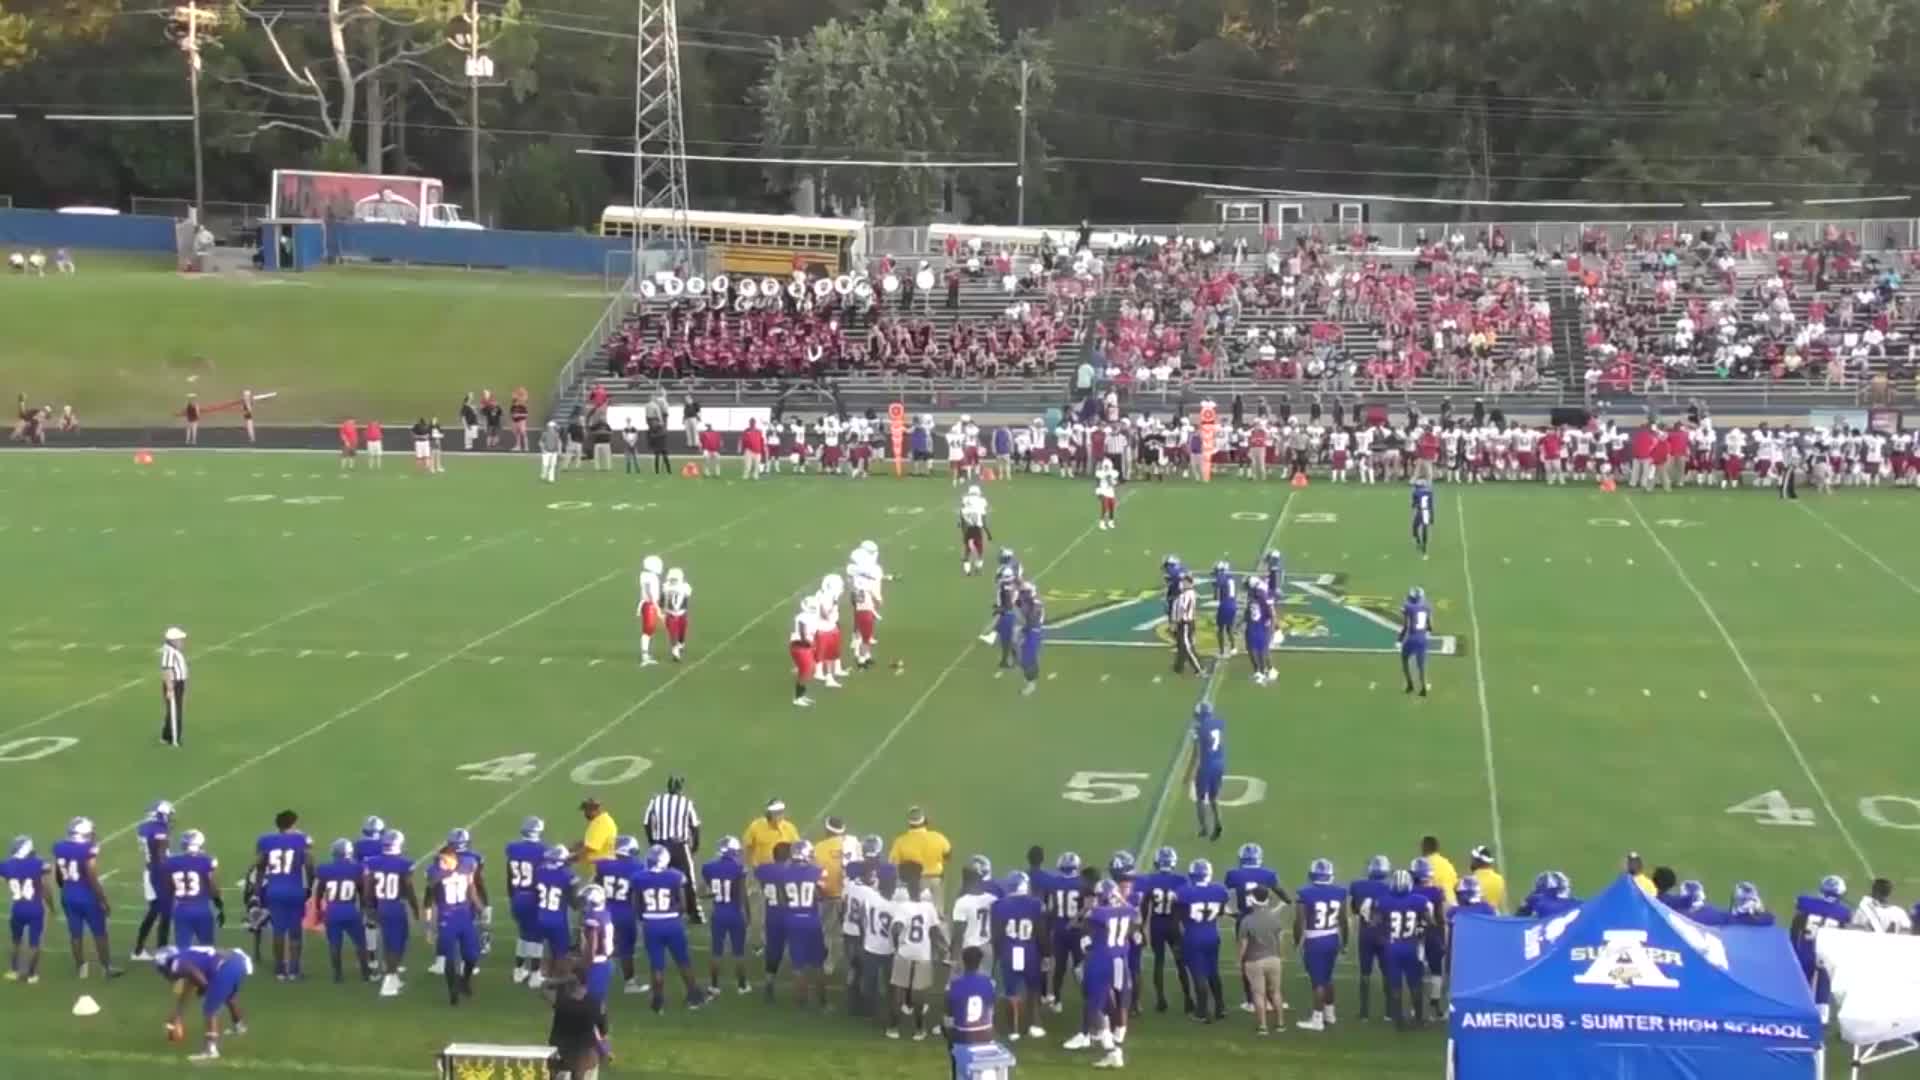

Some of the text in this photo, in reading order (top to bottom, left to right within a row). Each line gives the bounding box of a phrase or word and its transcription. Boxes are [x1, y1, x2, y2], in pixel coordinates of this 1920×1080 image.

[374, 872, 400, 900] 20
[1056, 890, 1079, 917] 16
[1314, 900, 1340, 930] 32
[1390, 911, 1416, 938] 33
[1462, 1012, 1564, 1029] AMERICUS
[1581, 1013, 1664, 1032] SUMTER
